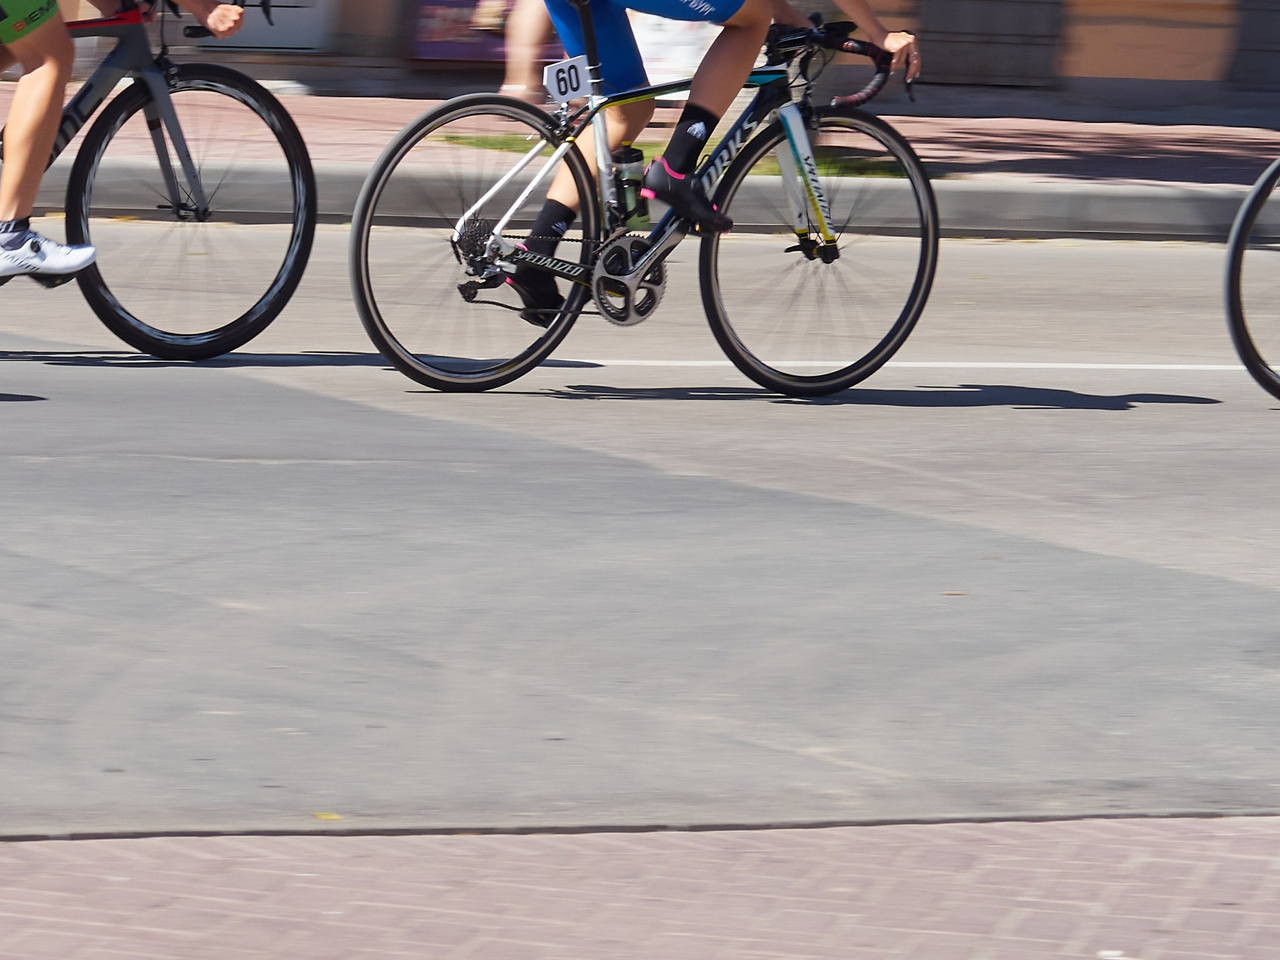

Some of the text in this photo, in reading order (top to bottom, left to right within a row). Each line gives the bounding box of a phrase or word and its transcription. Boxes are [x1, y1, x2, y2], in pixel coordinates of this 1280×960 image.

[556, 64, 580, 96] 60
[700, 111, 759, 192] ORKS
[514, 250, 585, 277] SPECIALIZED
